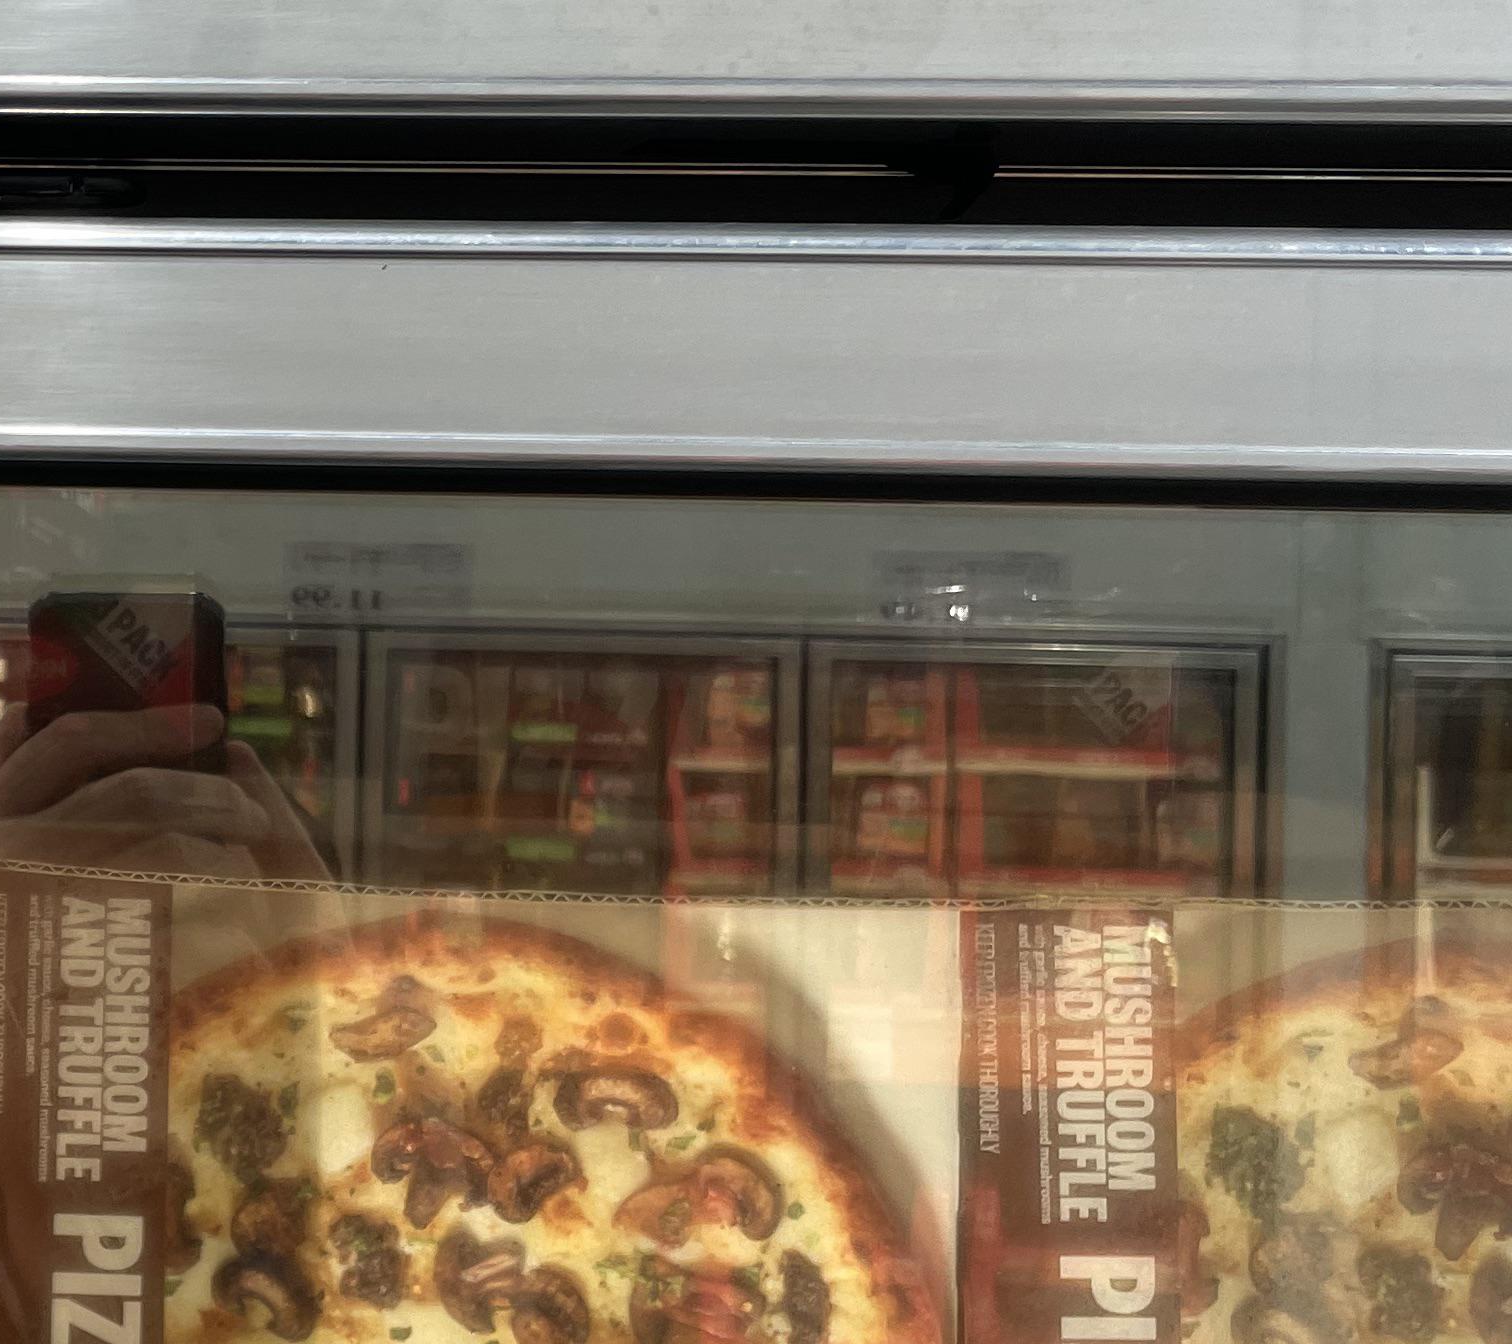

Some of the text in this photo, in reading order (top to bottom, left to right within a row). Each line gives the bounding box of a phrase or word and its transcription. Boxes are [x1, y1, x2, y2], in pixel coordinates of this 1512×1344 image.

[25, 968, 37, 1035] mushroom
[54, 896, 105, 1182] AND TRUFFLE
[101, 898, 151, 1152] MUSHROOM
[1052, 924, 1106, 1222] AND TRUFFLE
[1102, 925, 1155, 1190] MUSHROOM
[37, 1109, 49, 1183] mushrooms
[977, 1059, 999, 1154] THOROUGHLY
[1039, 1147, 1051, 1224] mushrooms
